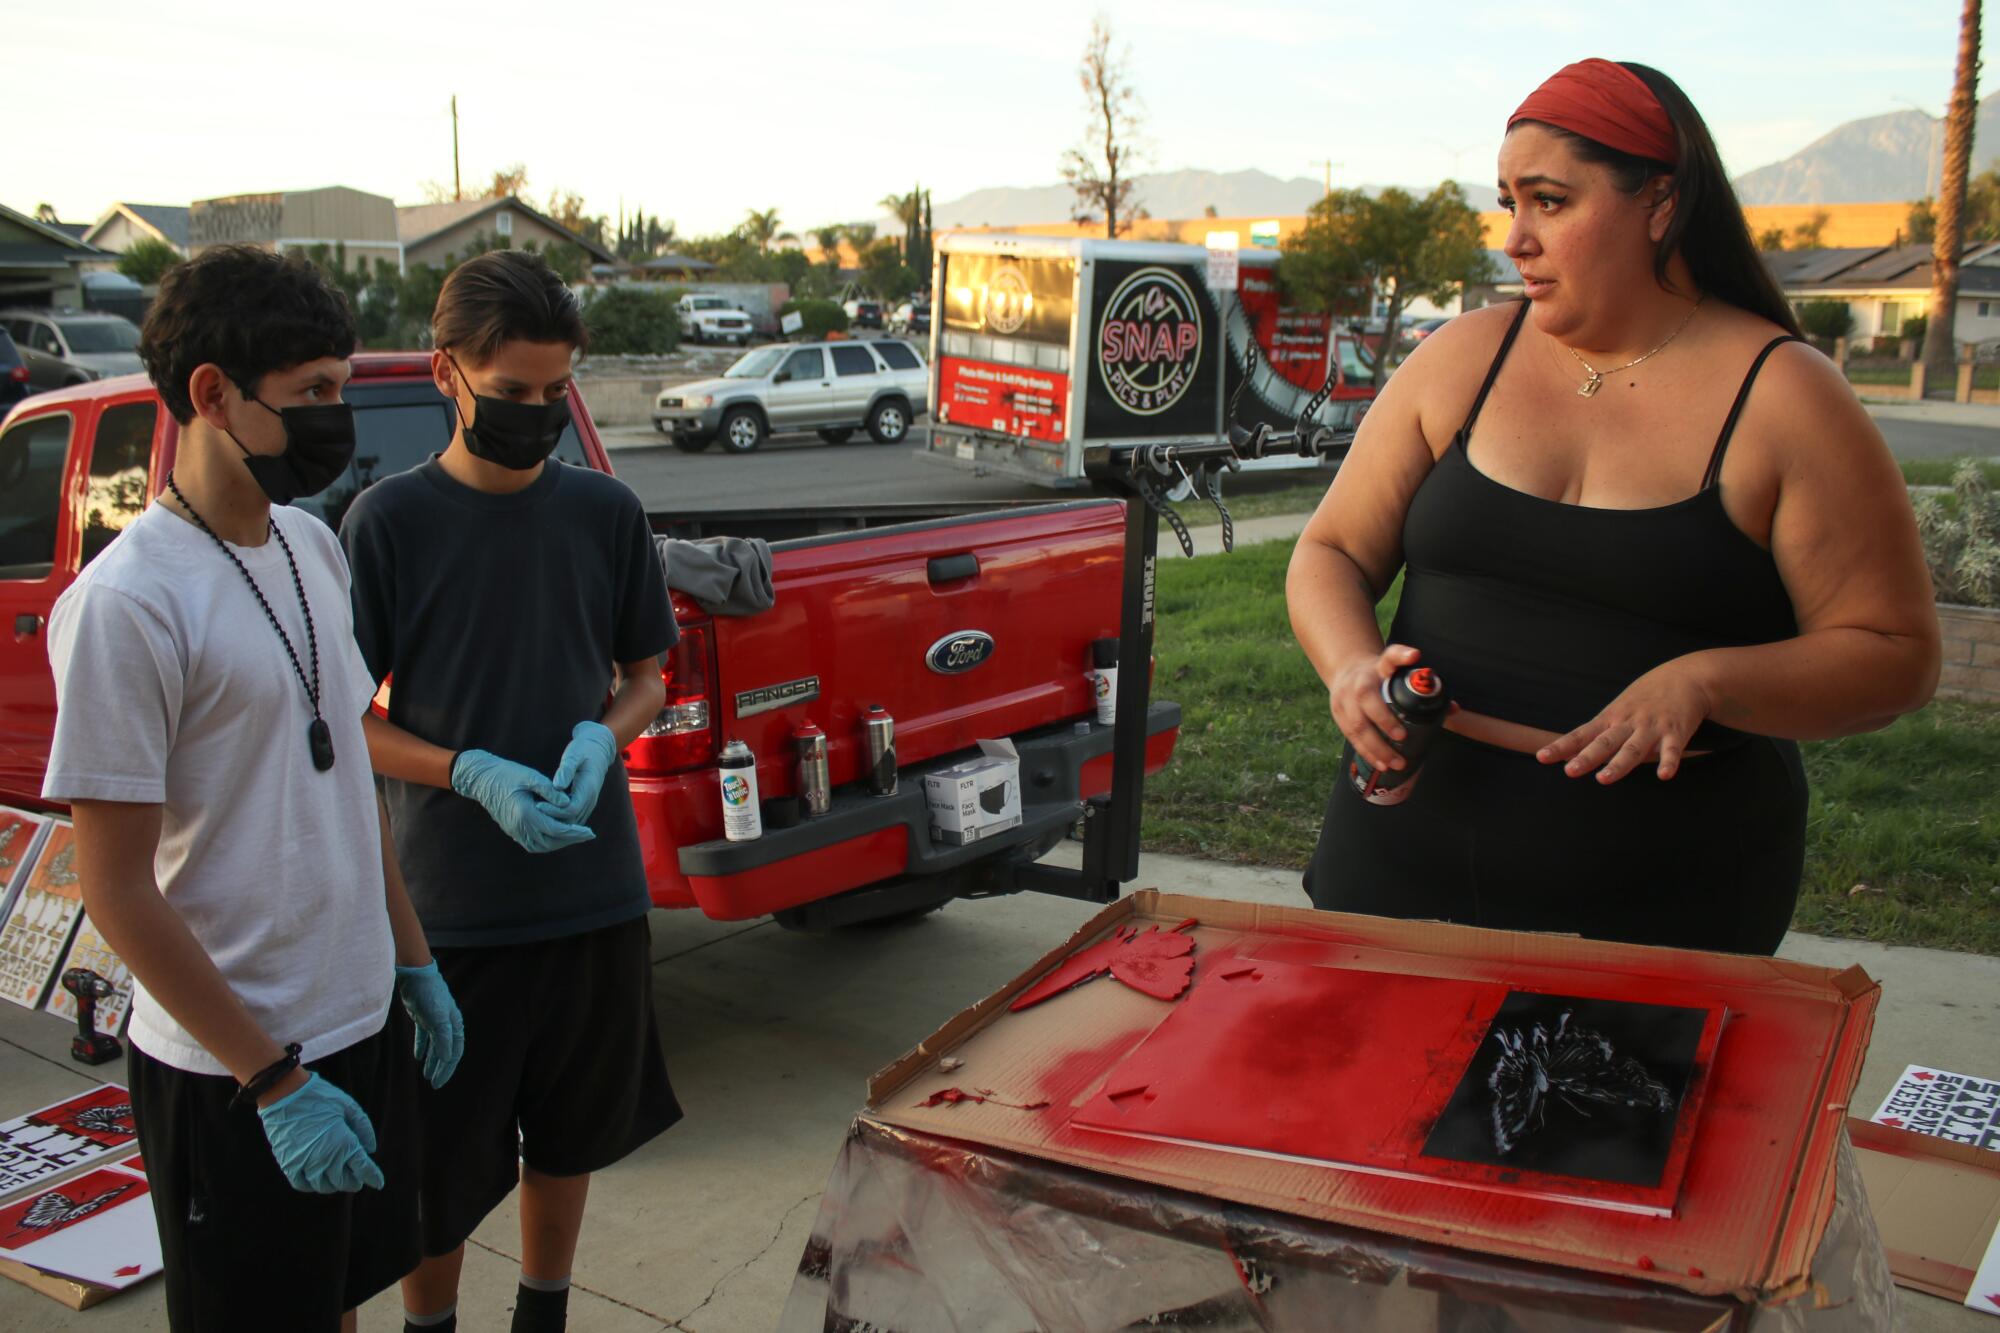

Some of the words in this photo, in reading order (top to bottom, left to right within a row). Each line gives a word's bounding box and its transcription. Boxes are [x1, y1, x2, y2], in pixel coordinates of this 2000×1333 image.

[1103, 320, 1198, 363] SNAP
[1110, 371, 1139, 406] PICS
[1141, 393, 1151, 408] &
[1155, 370, 1185, 406] PLAY
[947, 639, 984, 666] Ford
[738, 677, 820, 708] RANGER
[723, 776, 745, 792] Touch
[960, 780, 974, 790] FLTR
[961, 802, 975, 810] Face
[1884, 1080, 1928, 1117] HERE
